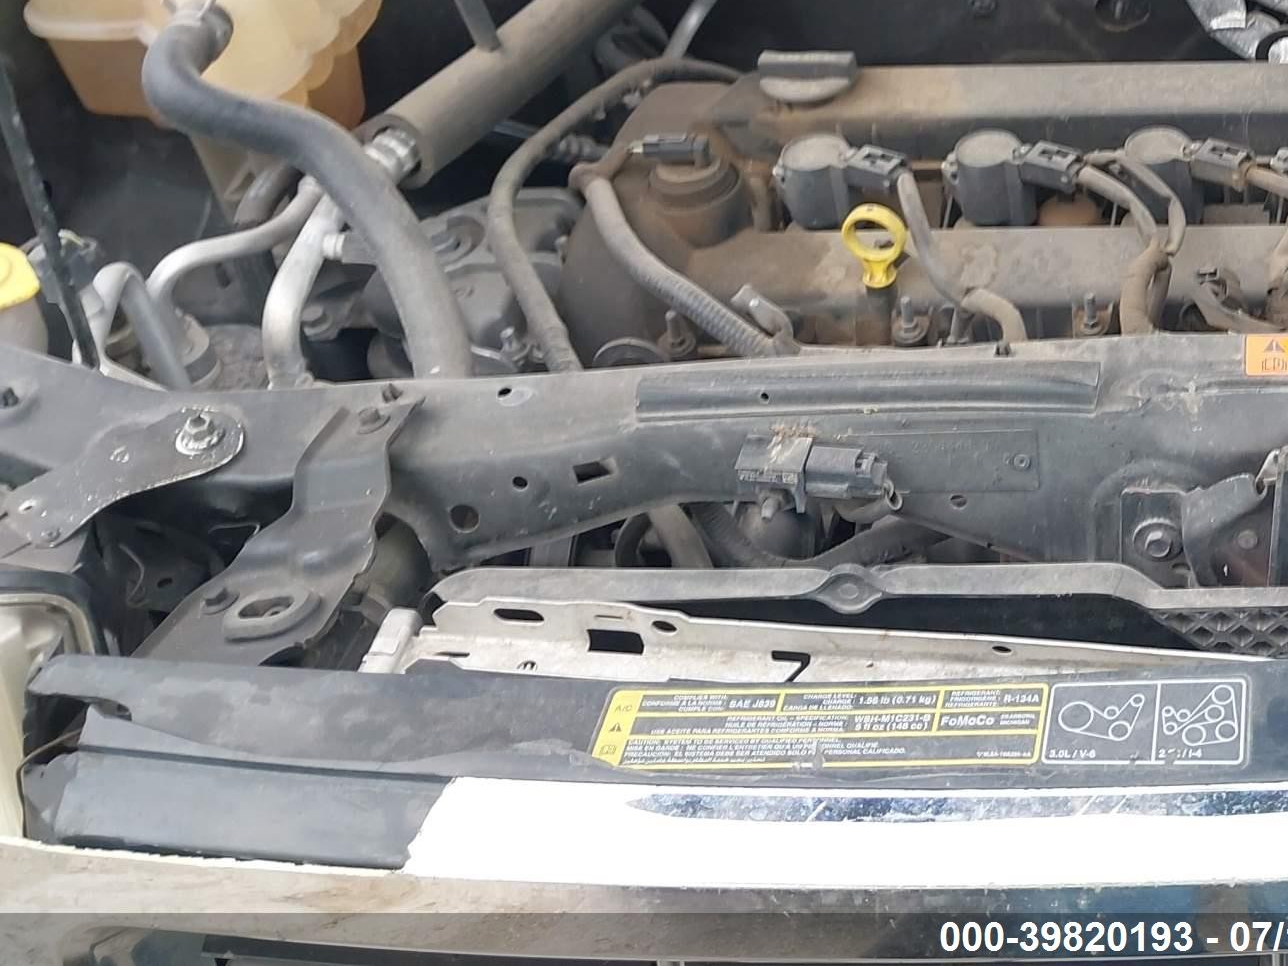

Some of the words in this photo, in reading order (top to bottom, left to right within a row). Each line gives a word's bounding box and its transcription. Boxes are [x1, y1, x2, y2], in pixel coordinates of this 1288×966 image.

[918, 694, 937, 705] kg)
[1003, 693, 1040, 703] R-134A
[728, 699, 751, 708] SAE
[614, 704, 633, 713] A/C
[940, 714, 995, 727] FoMoCo
[1078, 749, 1097, 758] V-6
